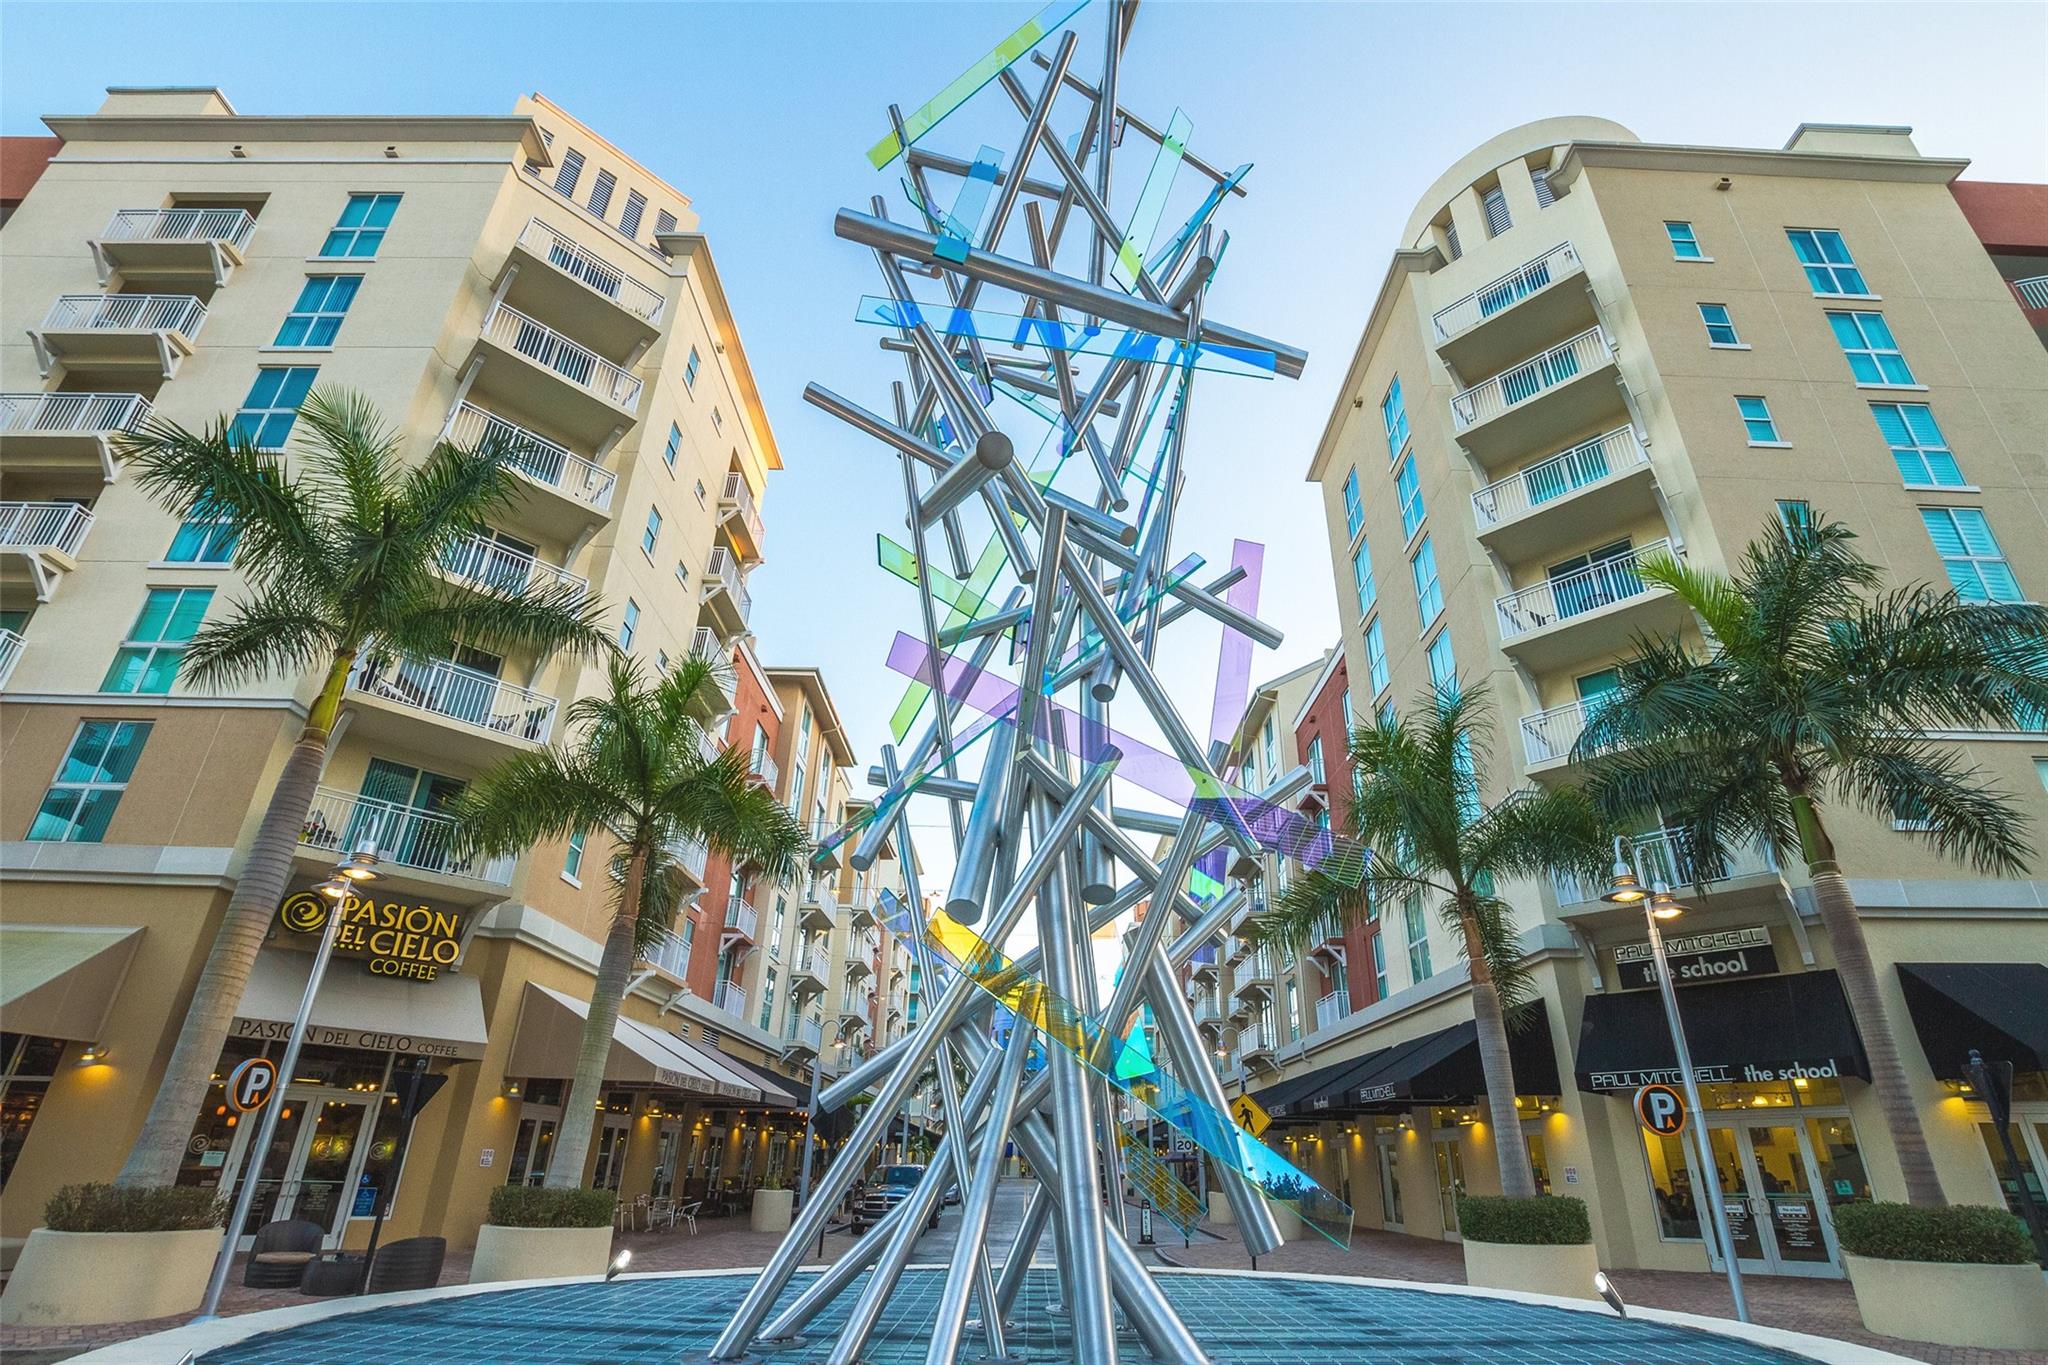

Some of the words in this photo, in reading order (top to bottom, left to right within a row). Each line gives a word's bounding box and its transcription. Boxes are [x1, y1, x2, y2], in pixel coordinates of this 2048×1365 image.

[369, 930, 460, 964] CIELO
[1615, 943, 1653, 960] PAU
[1666, 930, 1765, 954] MITCHELL
[370, 958, 438, 981] COFFEE
[1681, 951, 1748, 978] school
[323, 1031, 350, 1046] DEL
[359, 1032, 411, 1051] CIELO
[417, 1043, 458, 1057] COFFEE
[242, 1067, 270, 1105] P
[1591, 1072, 1638, 1088] PAUL
[1745, 1064, 1774, 1083] the
[1779, 1059, 1838, 1080] school
[1649, 1092, 1676, 1129] P
[1177, 1140, 1192, 1150] 20
